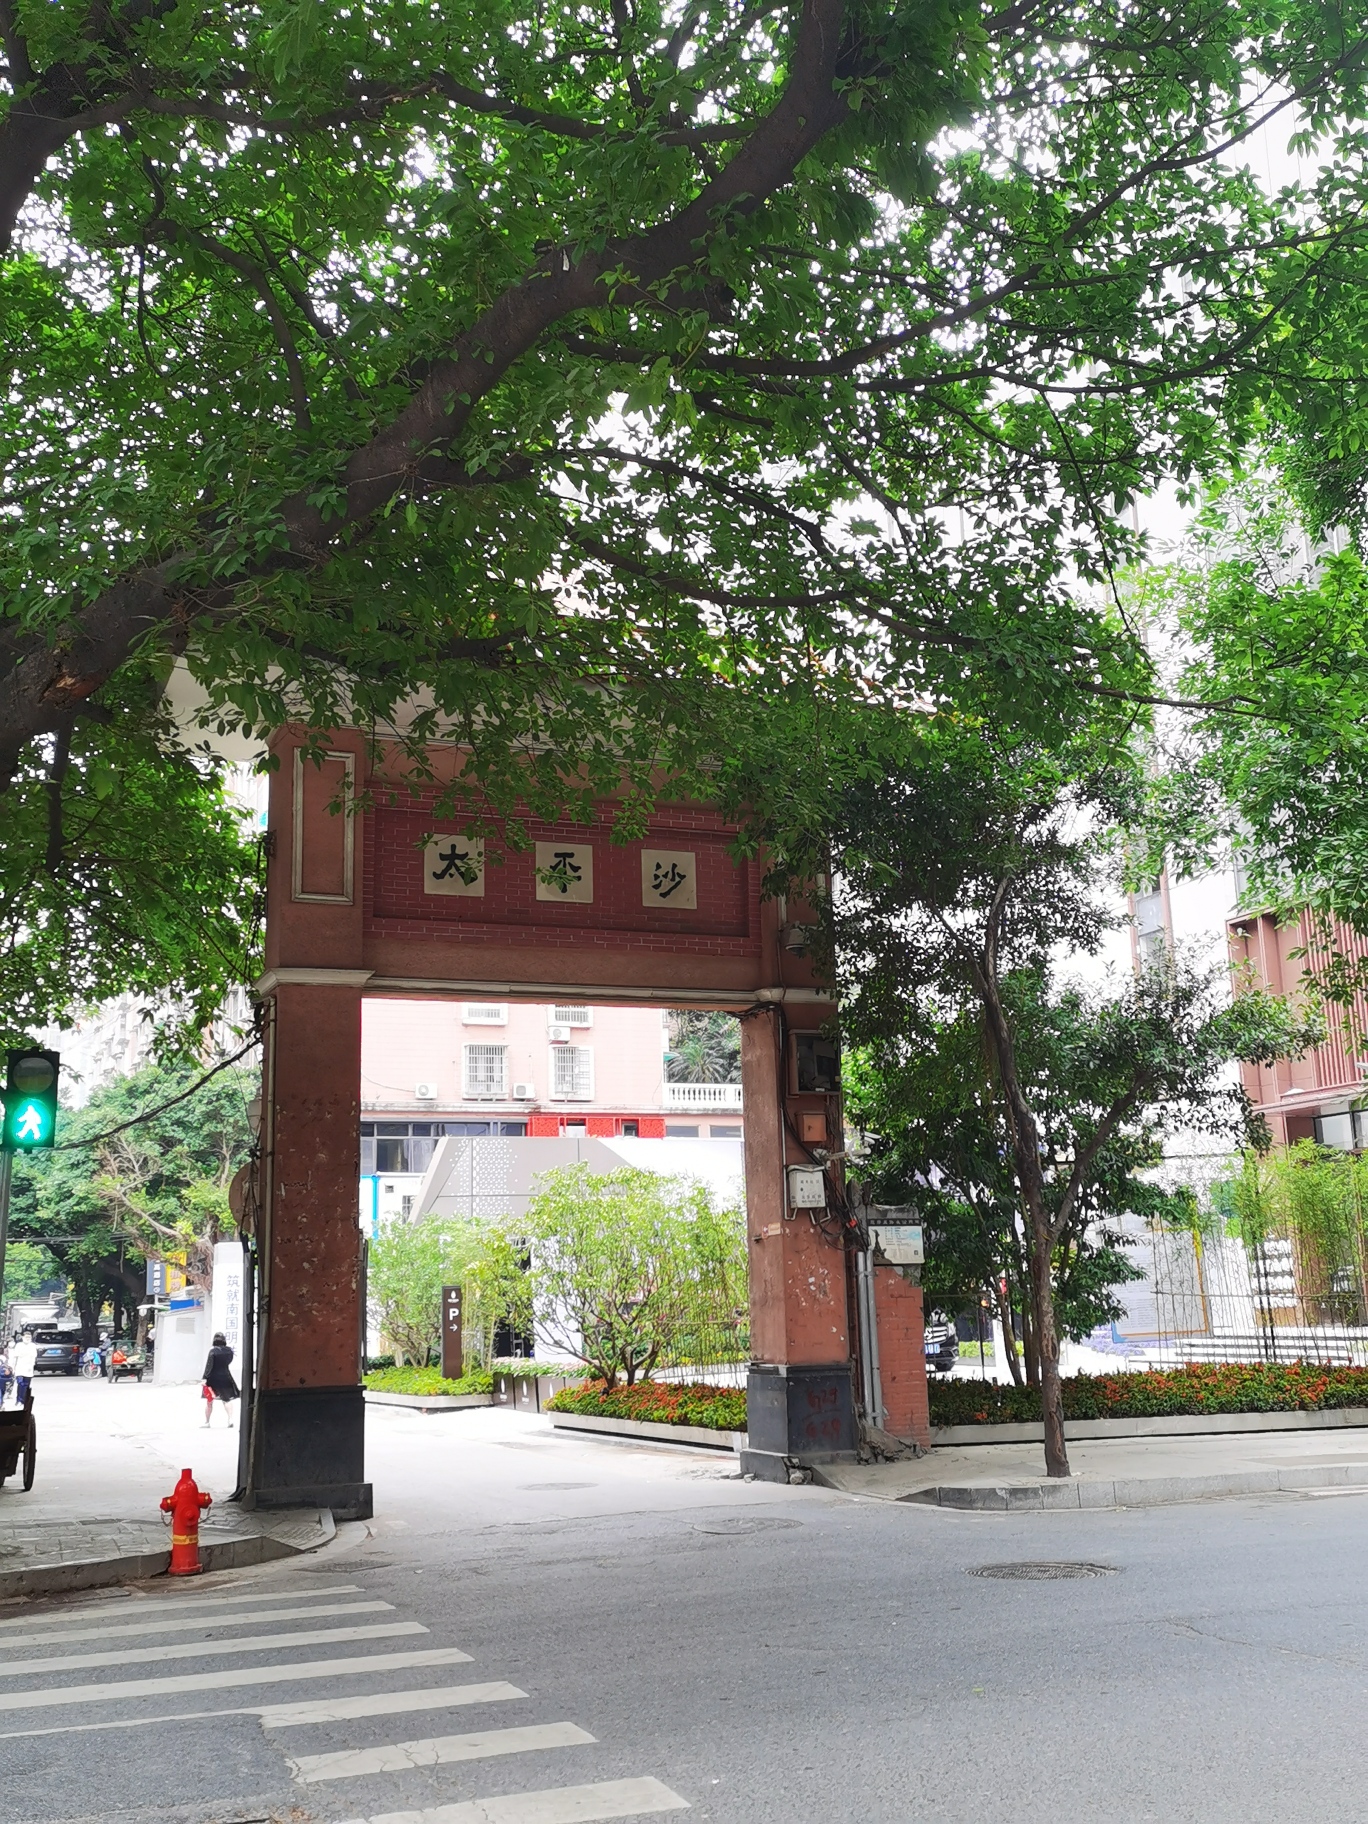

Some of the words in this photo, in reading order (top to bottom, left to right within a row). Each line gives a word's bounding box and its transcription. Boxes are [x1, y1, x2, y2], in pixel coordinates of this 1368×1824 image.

[432, 843, 687, 899] 太平沙
[449, 1307, 459, 1321] P
